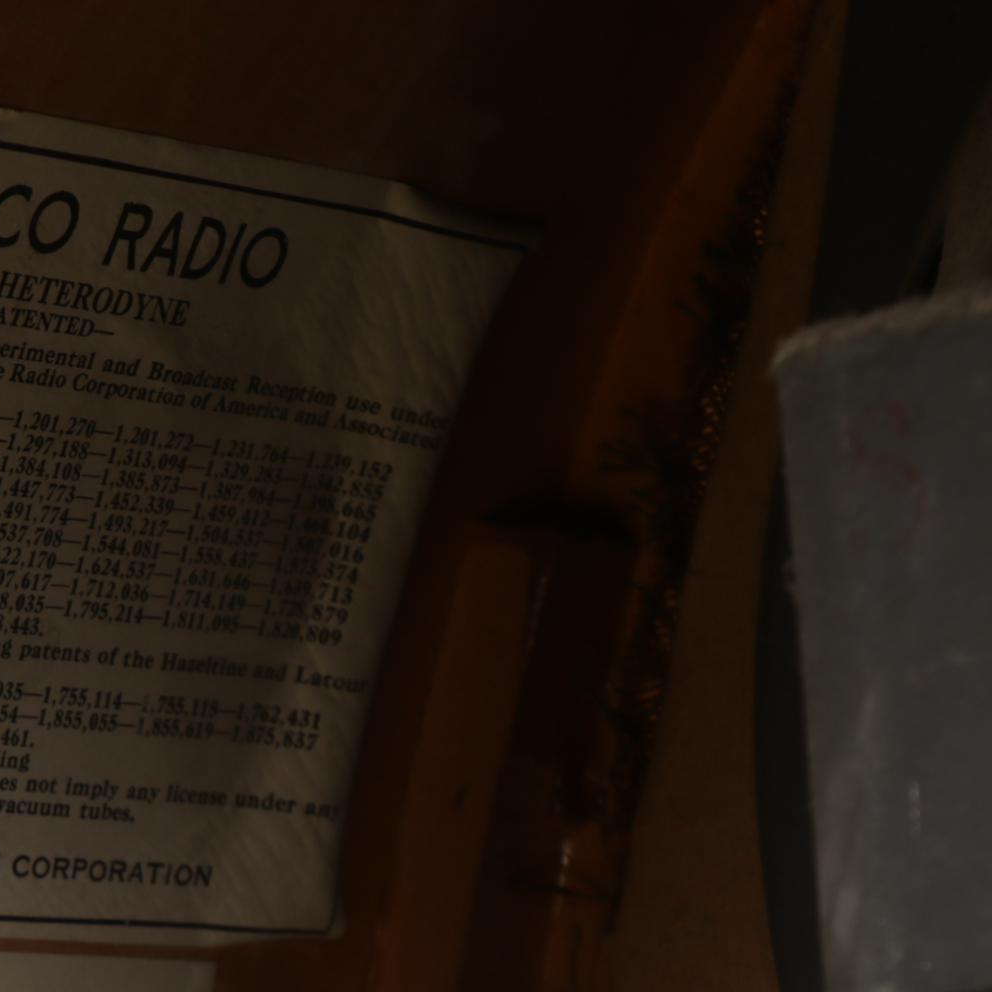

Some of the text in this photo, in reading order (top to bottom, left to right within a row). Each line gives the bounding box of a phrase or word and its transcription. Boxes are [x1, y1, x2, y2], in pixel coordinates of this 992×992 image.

[99, 200, 289, 289] RADIO
[8, 362, 67, 389] Radio
[71, 372, 186, 407] Corporation
[189, 392, 212, 411] of
[211, 395, 288, 421] America
[293, 409, 330, 428] and
[101, 357, 142, 377] and
[146, 360, 239, 392] Broadcast
[245, 374, 337, 407] Reception
[344, 394, 382, 415] use
[17, 643, 91, 663] patents
[95, 645, 120, 666] of
[121, 648, 155, 670] the
[159, 651, 248, 678] Hazeltine
[251, 662, 288, 682] and
[293, 664, 366, 693] Latour
[24, 777, 58, 794] not
[64, 776, 119, 801] imply
[124, 784, 160, 805] any
[164, 782, 228, 806] license
[233, 791, 297, 814] under
[78, 801, 135, 823] tubes.
[10, 853, 213, 888] CORPORATION
